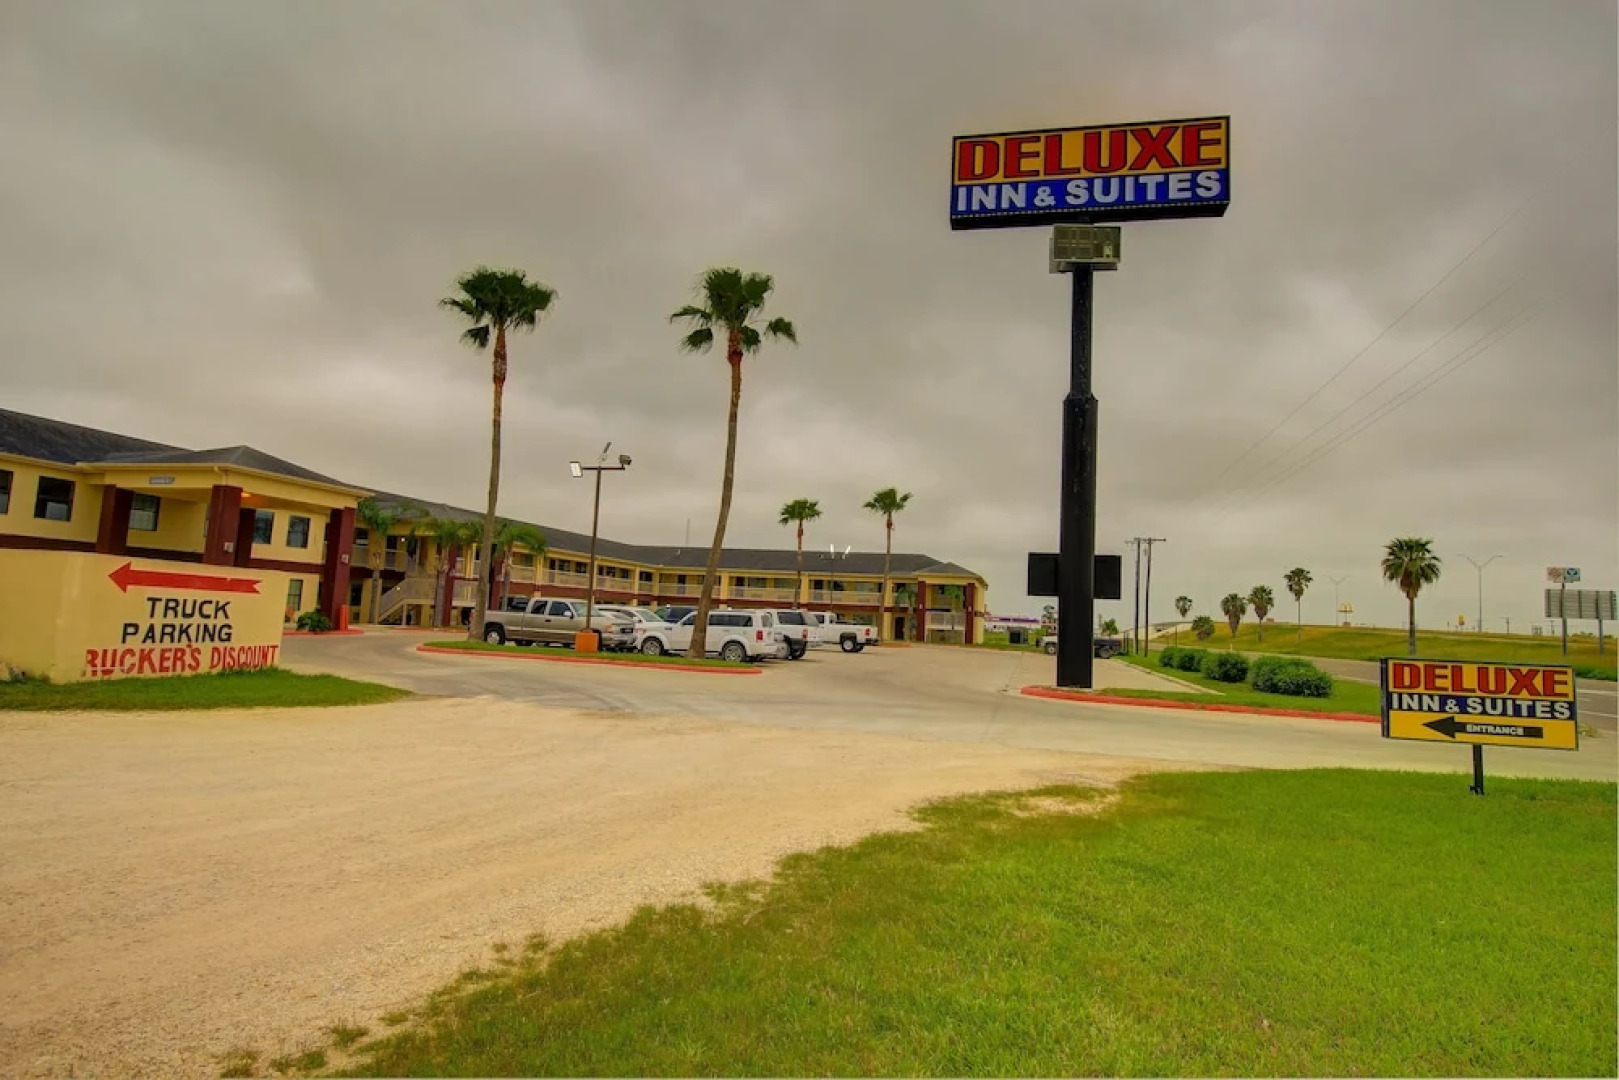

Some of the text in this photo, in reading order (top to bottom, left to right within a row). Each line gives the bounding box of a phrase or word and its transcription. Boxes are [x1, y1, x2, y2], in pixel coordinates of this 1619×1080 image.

[958, 122, 1222, 181] DELUXE
[957, 171, 1221, 211] INN & SUITES
[147, 597, 231, 620] TRUCK
[121, 623, 233, 644] PARKING
[209, 645, 279, 671] DISCOUNT
[1392, 662, 1569, 698] DELUXE
[1392, 693, 1571, 719] INN & SUITES
[1466, 724, 1524, 736] ENTRANCE
